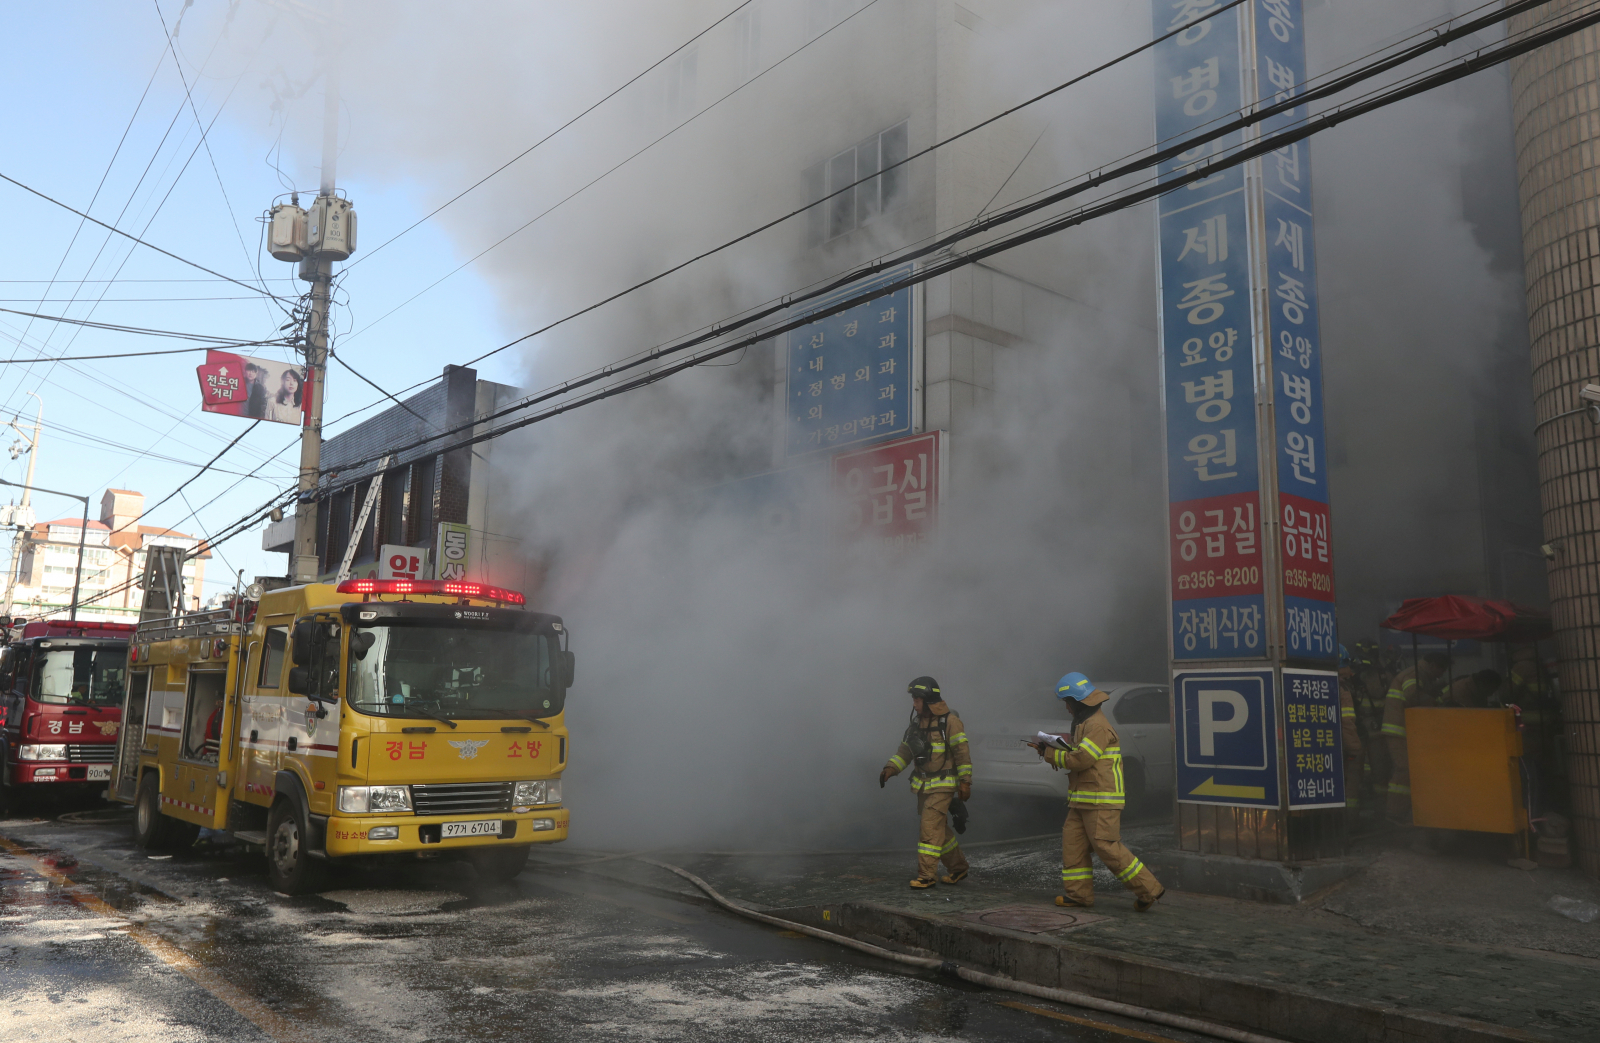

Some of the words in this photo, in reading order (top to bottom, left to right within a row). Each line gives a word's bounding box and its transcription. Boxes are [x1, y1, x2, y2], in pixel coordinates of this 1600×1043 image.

[207, 374, 239, 390] 전도연
[211, 387, 232, 400] 거리
[808, 409, 897, 445] 가정의학과
[844, 453, 927, 531] 응급실
[1176, 503, 1256, 561] 응급실
[1283, 504, 1328, 563] 응급실
[1190, 566, 1259, 589] 356-8200
[1293, 569, 1331, 592] 356-8200
[1178, 605, 1261, 651] 장례식장
[1287, 606, 1333, 653] 장례식장
[1292, 679, 1329, 699] 주차장은
[48, 720, 84, 734] 경남
[1198, 690, 1249, 756] P
[1293, 728, 1311, 748] 넓은
[1316, 729, 1335, 747] 무료
[386, 741, 427, 760] 경남
[507, 741, 542, 759] 소방
[1296, 753, 1333, 772] 주차장이
[1297, 778, 1335, 798] 있습니다
[335, 830, 349, 840] 경남
[351, 831, 367, 840] 소방
[471, 822, 496, 834] 6704
